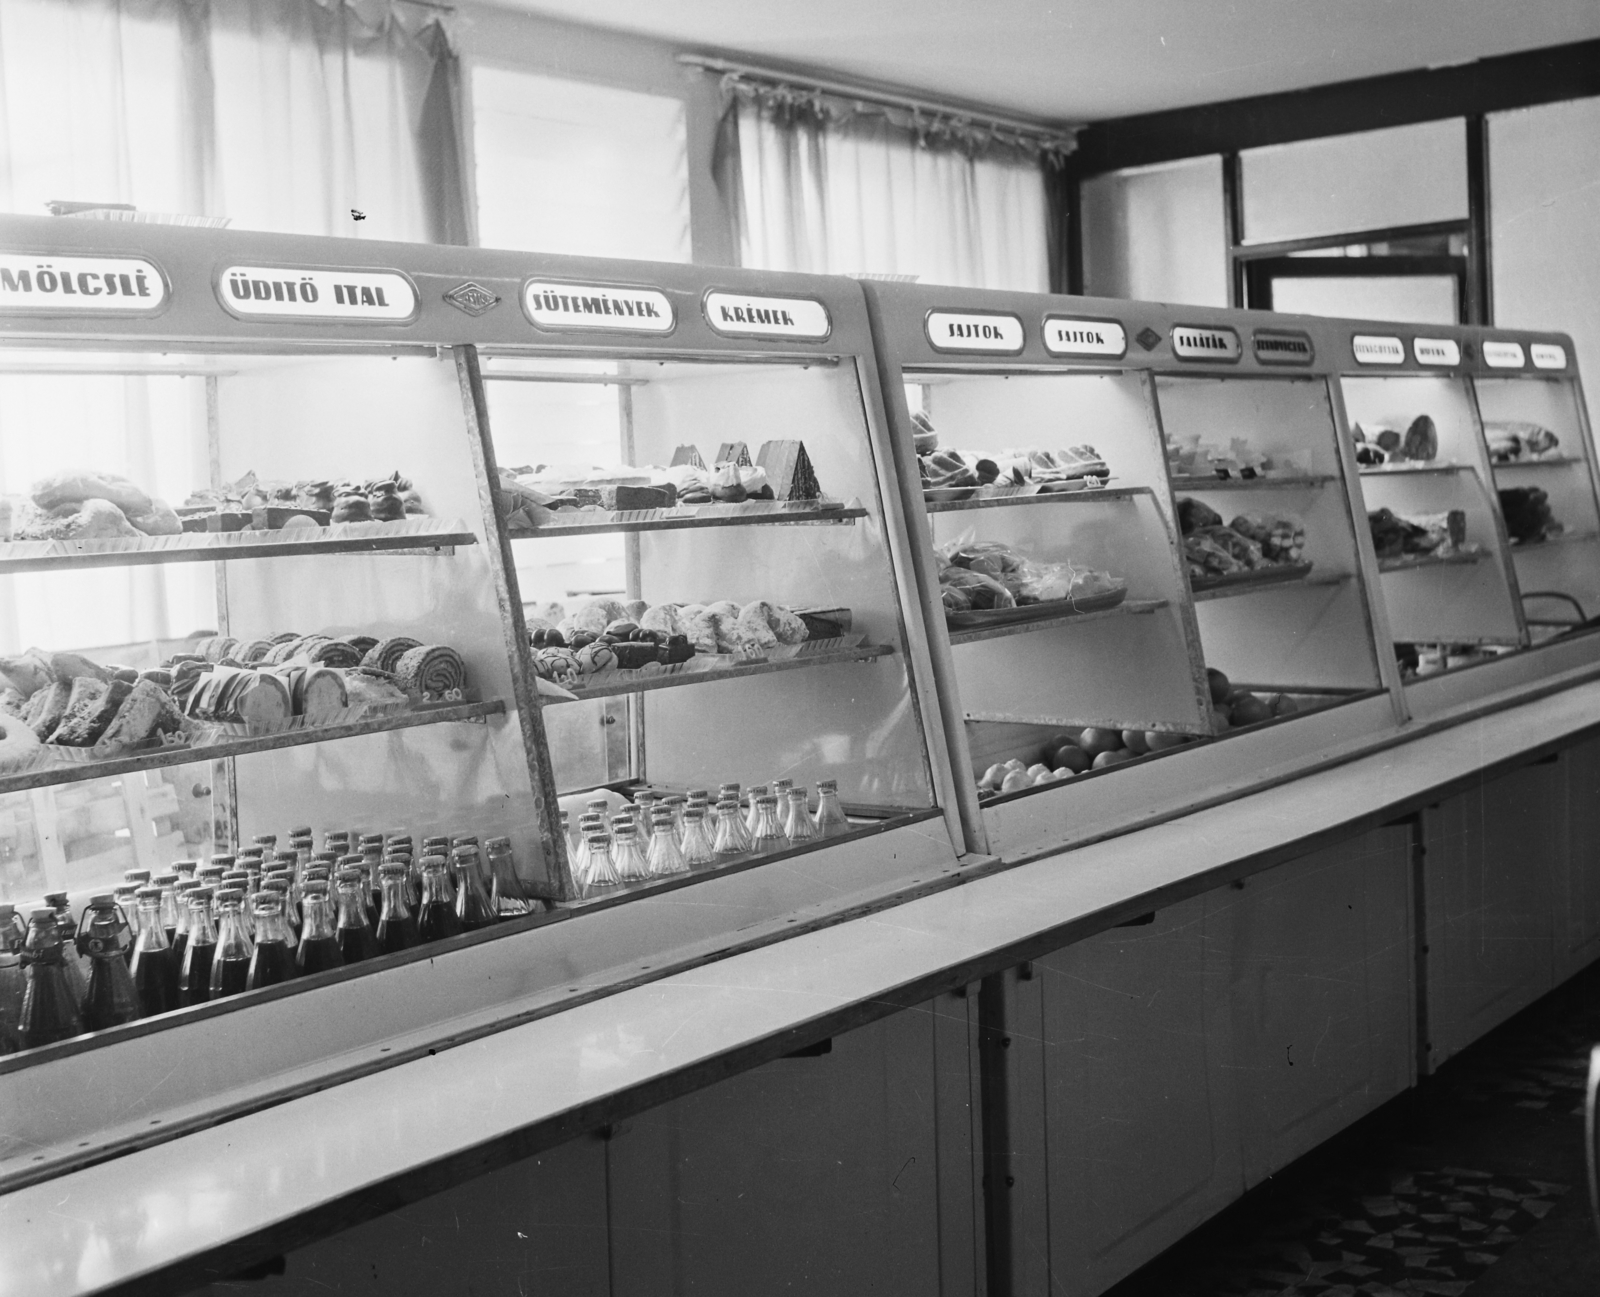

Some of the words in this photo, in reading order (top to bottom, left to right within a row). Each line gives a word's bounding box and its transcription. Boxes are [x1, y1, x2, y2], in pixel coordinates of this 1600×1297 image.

[333, 284, 390, 307] ITAL
[532, 290, 661, 318] SÜTEMÉNYEK
[720, 303, 795, 326] KRÉMEK
[949, 323, 1004, 340] SAJTOK
[1057, 329, 1105, 345] SAJTOK
[1179, 332, 1228, 350] SALÁTÁK
